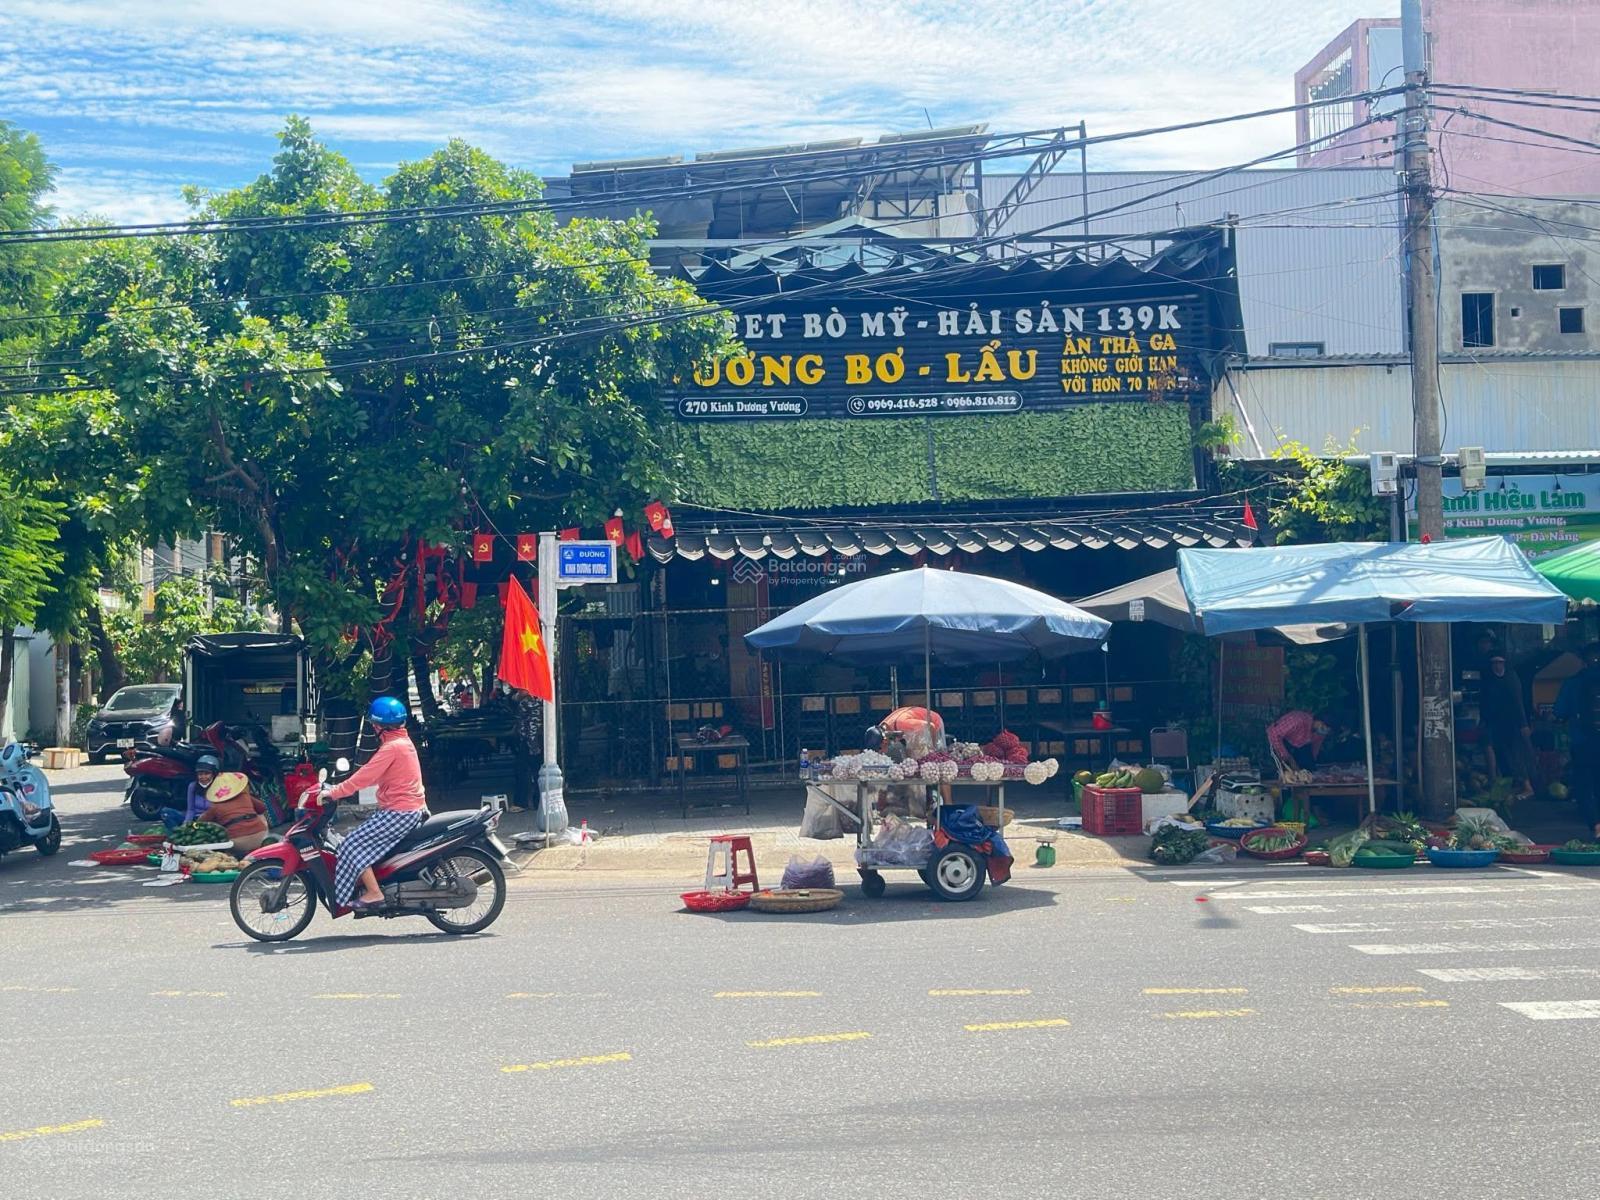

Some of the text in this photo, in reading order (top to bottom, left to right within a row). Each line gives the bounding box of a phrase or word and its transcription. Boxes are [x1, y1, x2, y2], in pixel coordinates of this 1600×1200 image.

[803, 306, 847, 338] BÒ
[861, 306, 910, 337] MỸ
[937, 302, 1001, 336] HẢI
[1015, 300, 1085, 334] SẢN
[1098, 305, 1181, 331] 139K
[1062, 330, 1177, 355] ĂN THẢ GA
[844, 346, 905, 385] BƠ
[945, 340, 1039, 383] LẨU
[1061, 355, 1107, 374] KHÔNG
[1115, 354, 1143, 373] GIỚI
[1062, 375, 1176, 393] VỚI HƠN 70 MN
[685, 400, 801, 414] 270 Kinh Dương Vương
[868, 398, 938, 410] 0969.416.528
[947, 396, 1017, 408] 0966.810.812
[1456, 518, 1484, 528] Kinh
